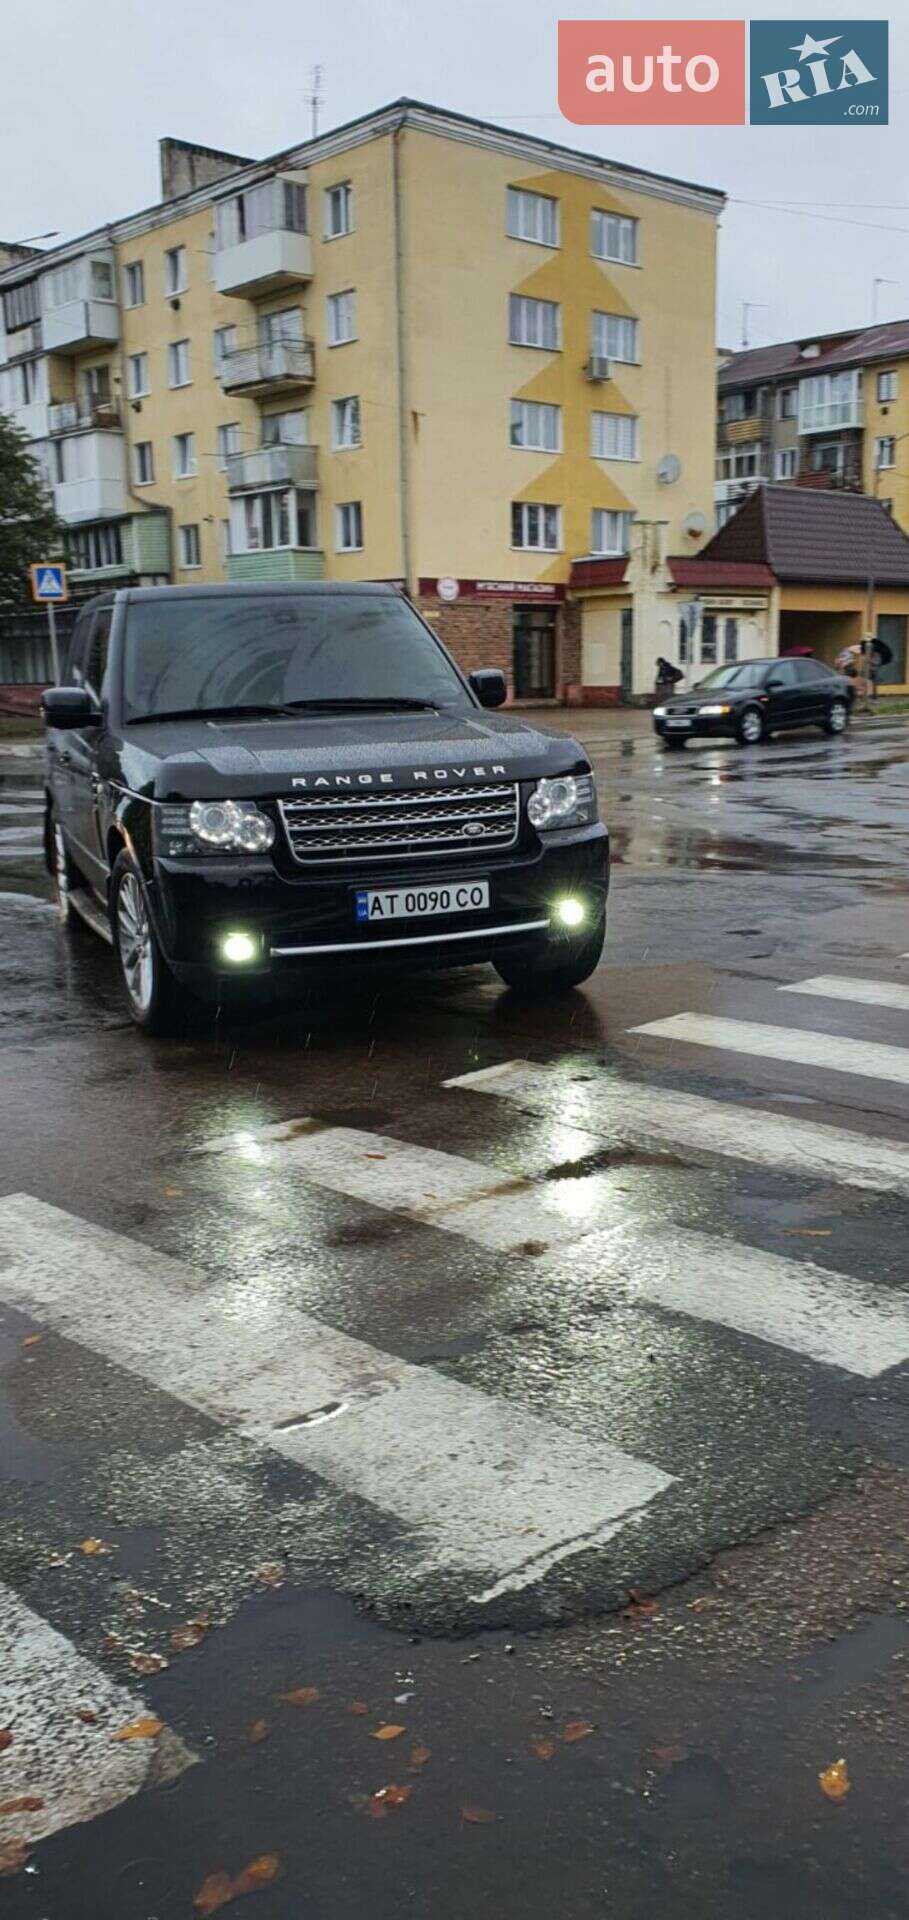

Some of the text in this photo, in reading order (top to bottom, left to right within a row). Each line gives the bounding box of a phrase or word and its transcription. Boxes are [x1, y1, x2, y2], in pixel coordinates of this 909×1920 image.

[292, 765, 507, 787] RANGE ROVER
[370, 887, 483, 916] AT 0090 CO
